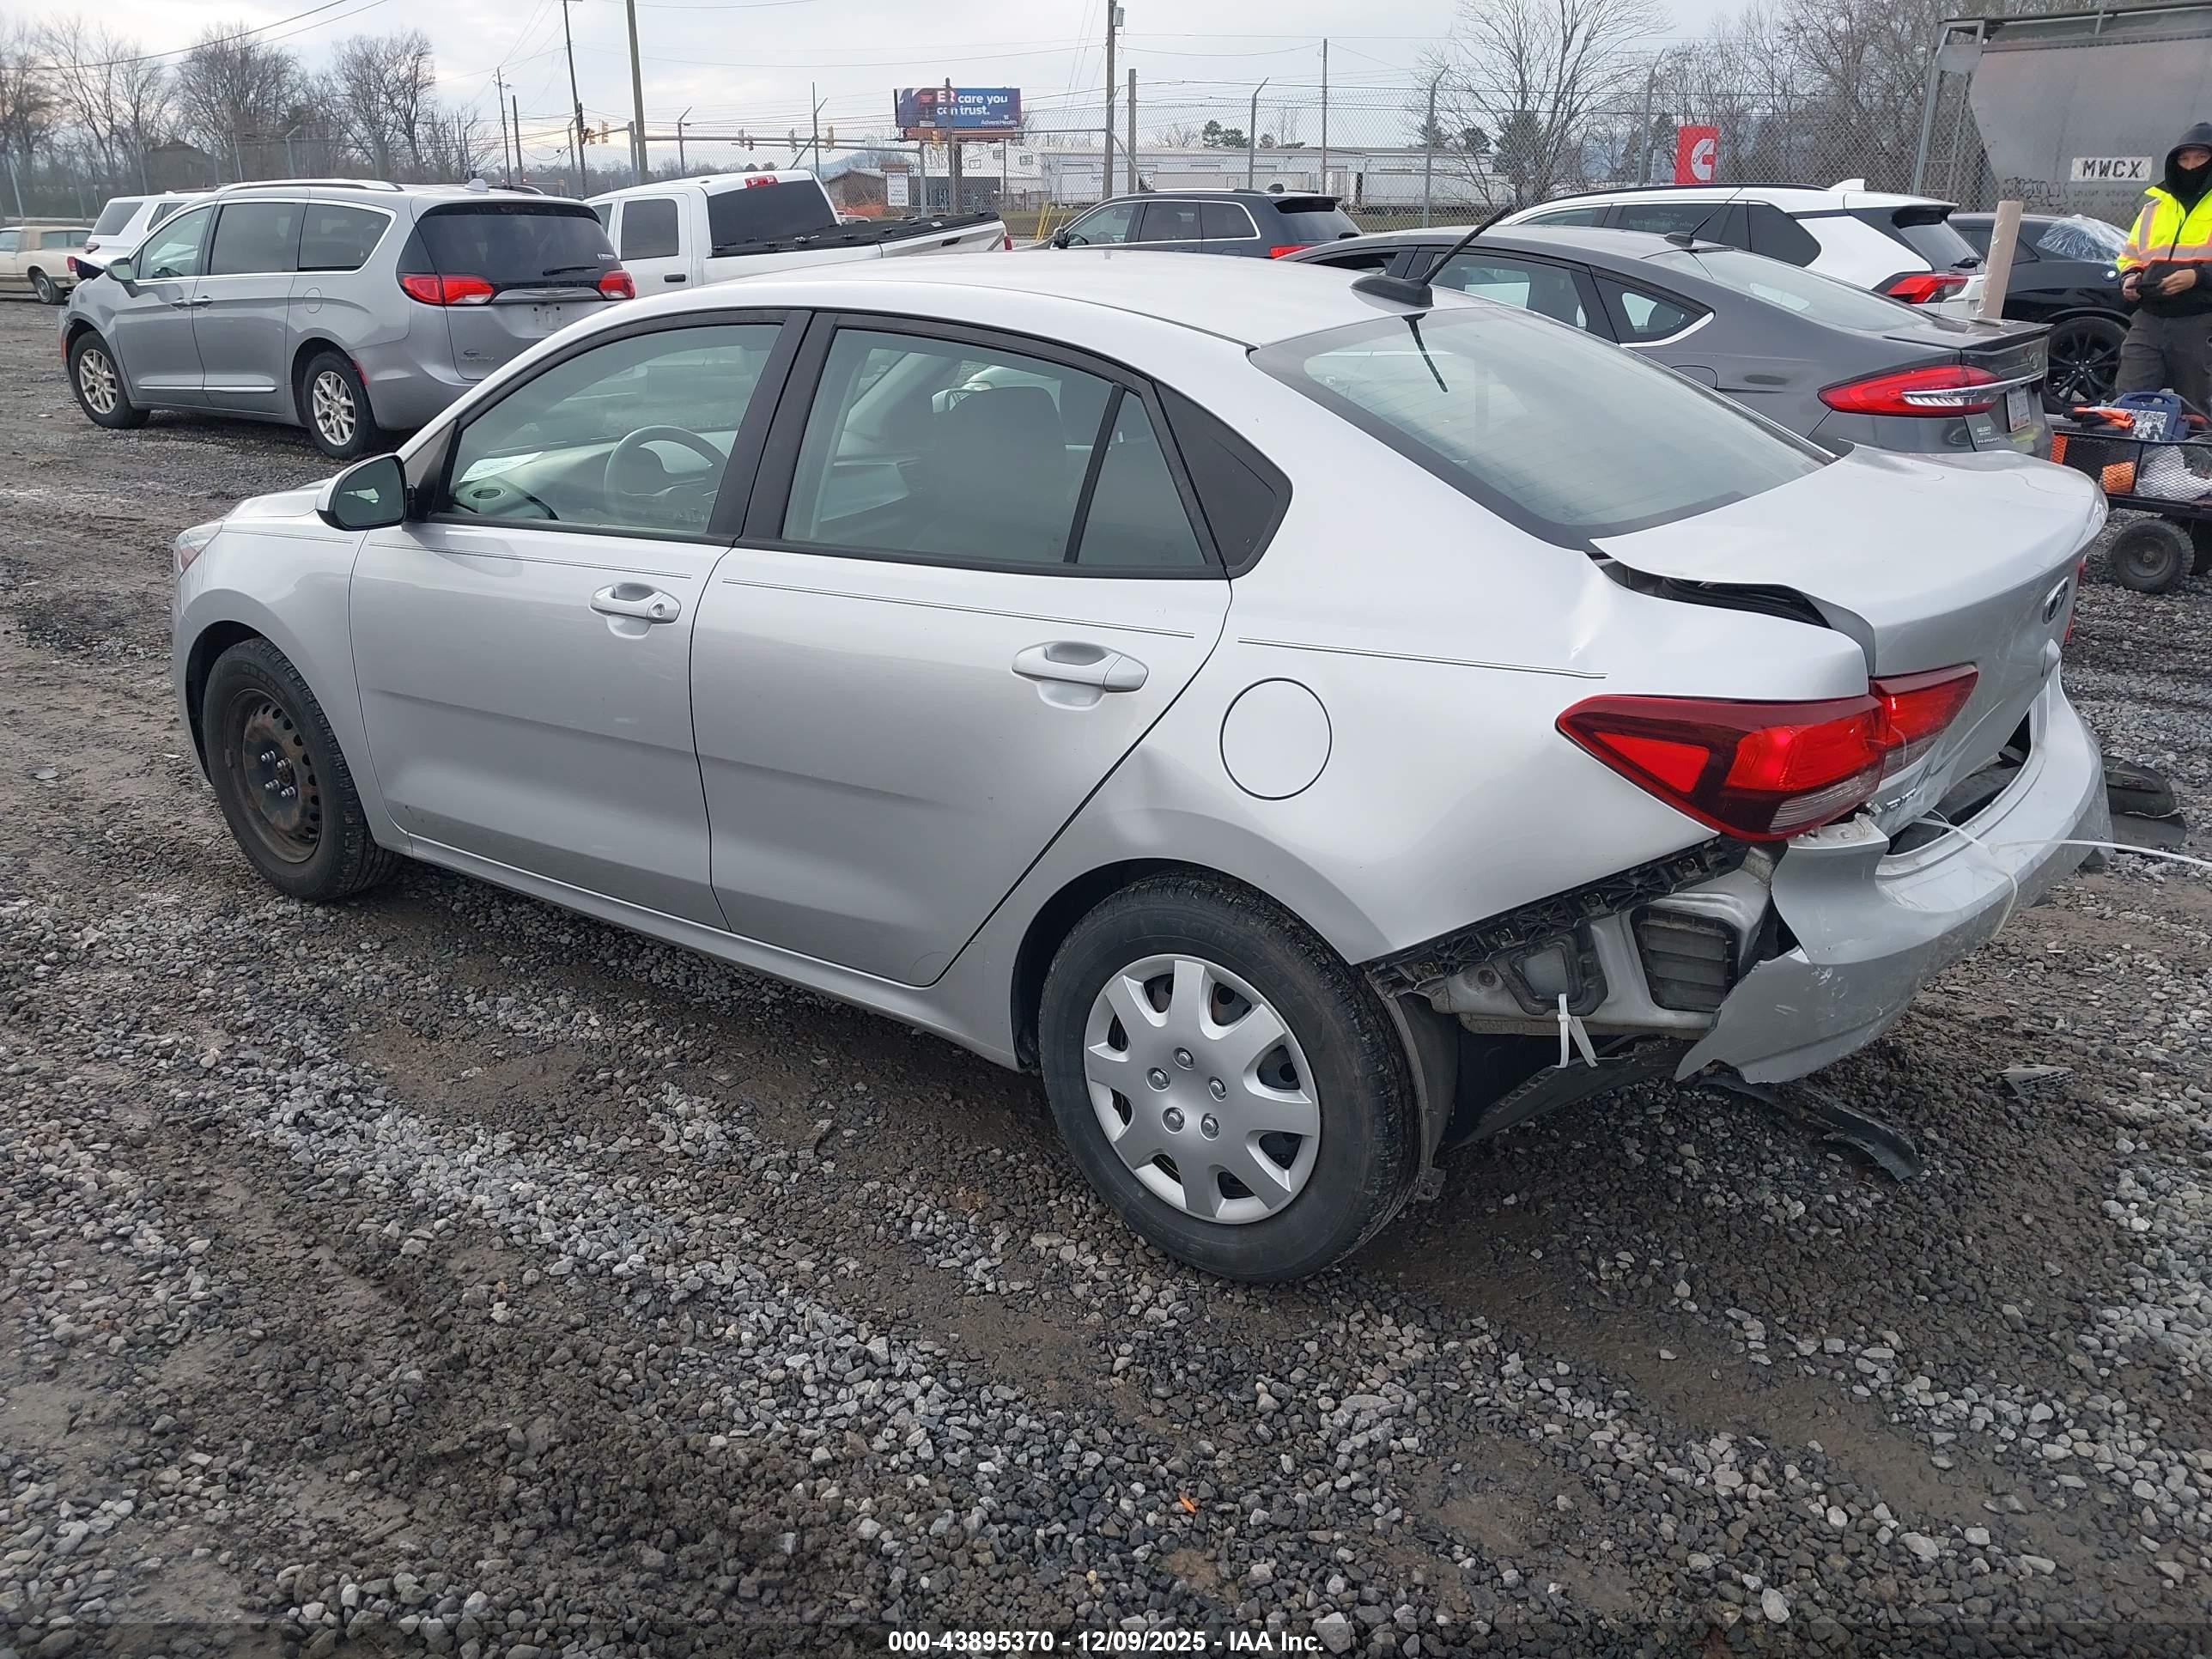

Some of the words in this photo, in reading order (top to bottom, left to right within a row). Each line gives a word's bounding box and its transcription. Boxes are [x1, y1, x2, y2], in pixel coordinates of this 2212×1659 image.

[987, 95, 1008, 104] you
[960, 105, 990, 115] trust.
[2082, 160, 2142, 178] MWCX
